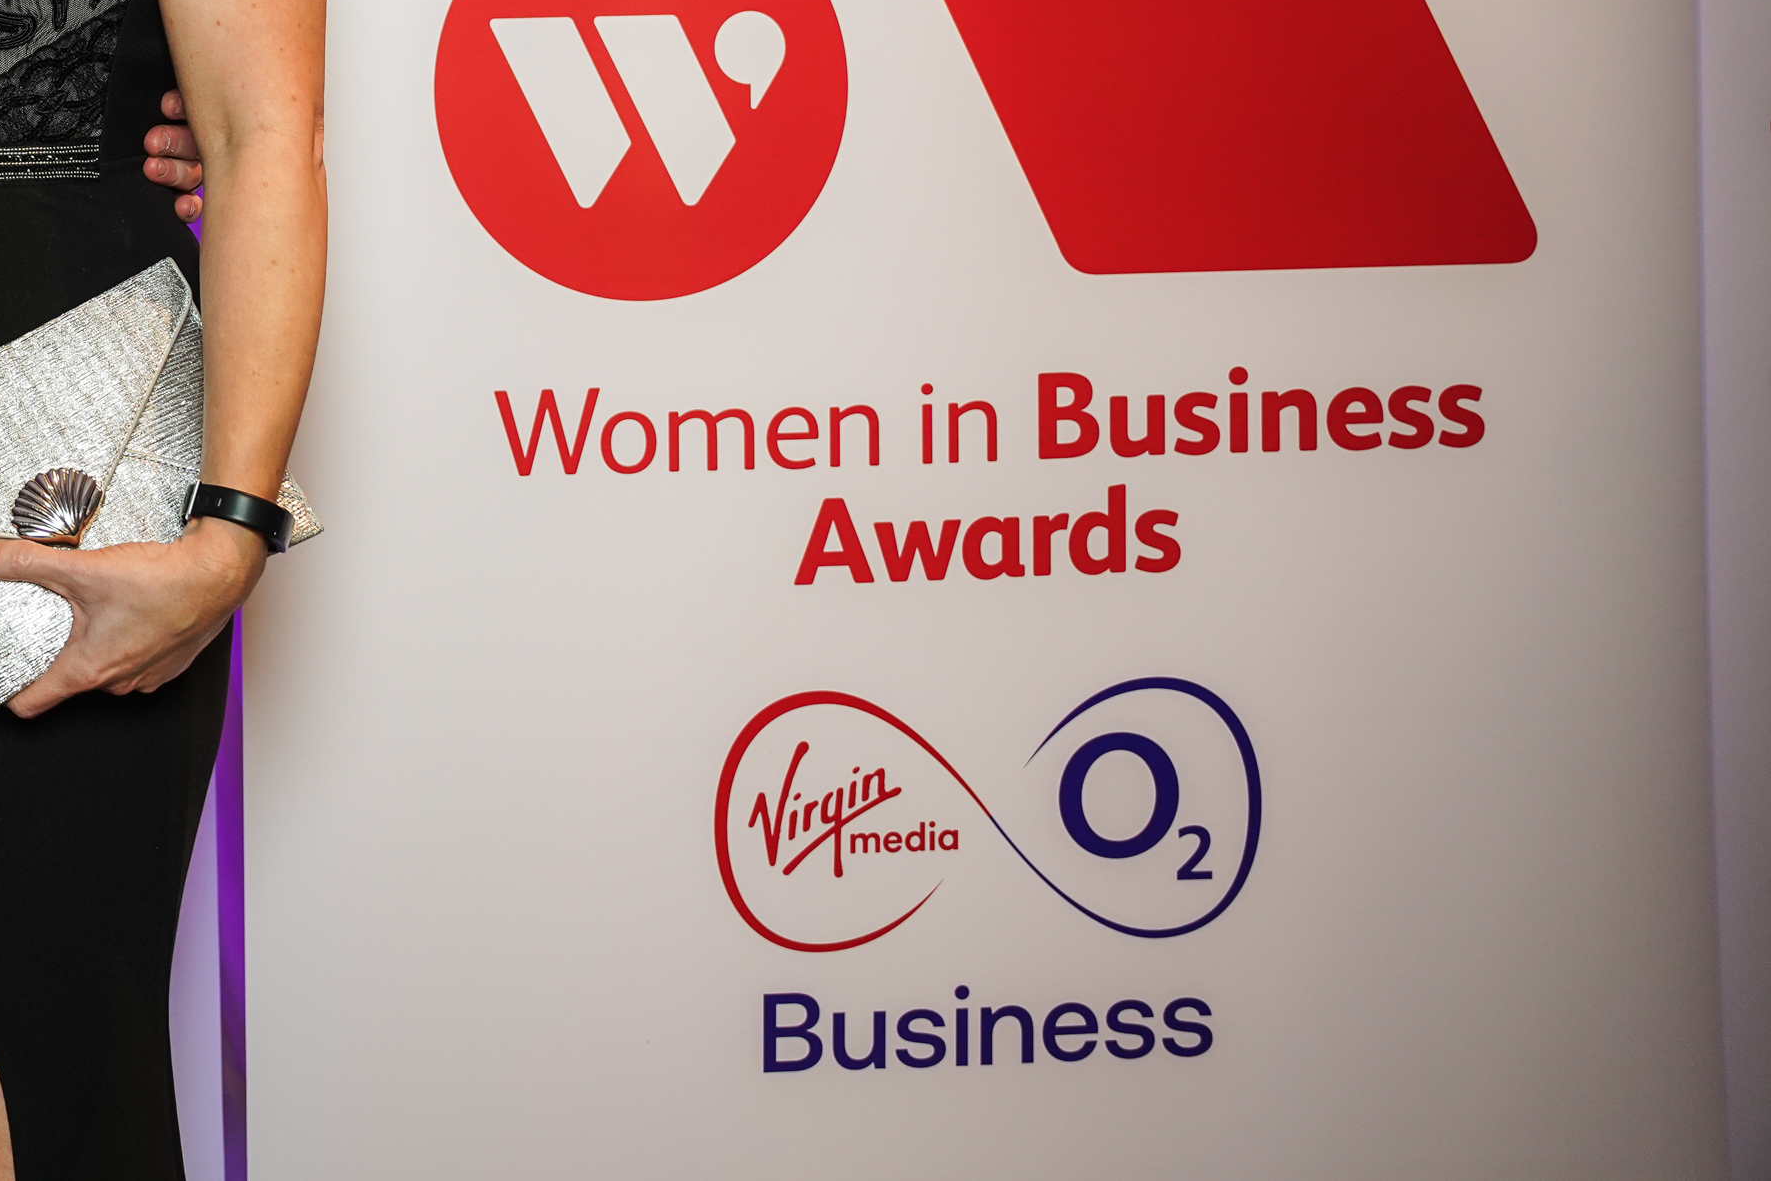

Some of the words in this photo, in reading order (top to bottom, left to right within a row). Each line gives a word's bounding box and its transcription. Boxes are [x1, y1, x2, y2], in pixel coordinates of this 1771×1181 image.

[493, 387, 880, 477] Women
[920, 382, 998, 465] in
[1037, 366, 1486, 460] Business
[793, 483, 1182, 586] Awards
[747, 740, 903, 879] Virgin
[849, 820, 959, 855] media
[762, 984, 1214, 1073] Business
